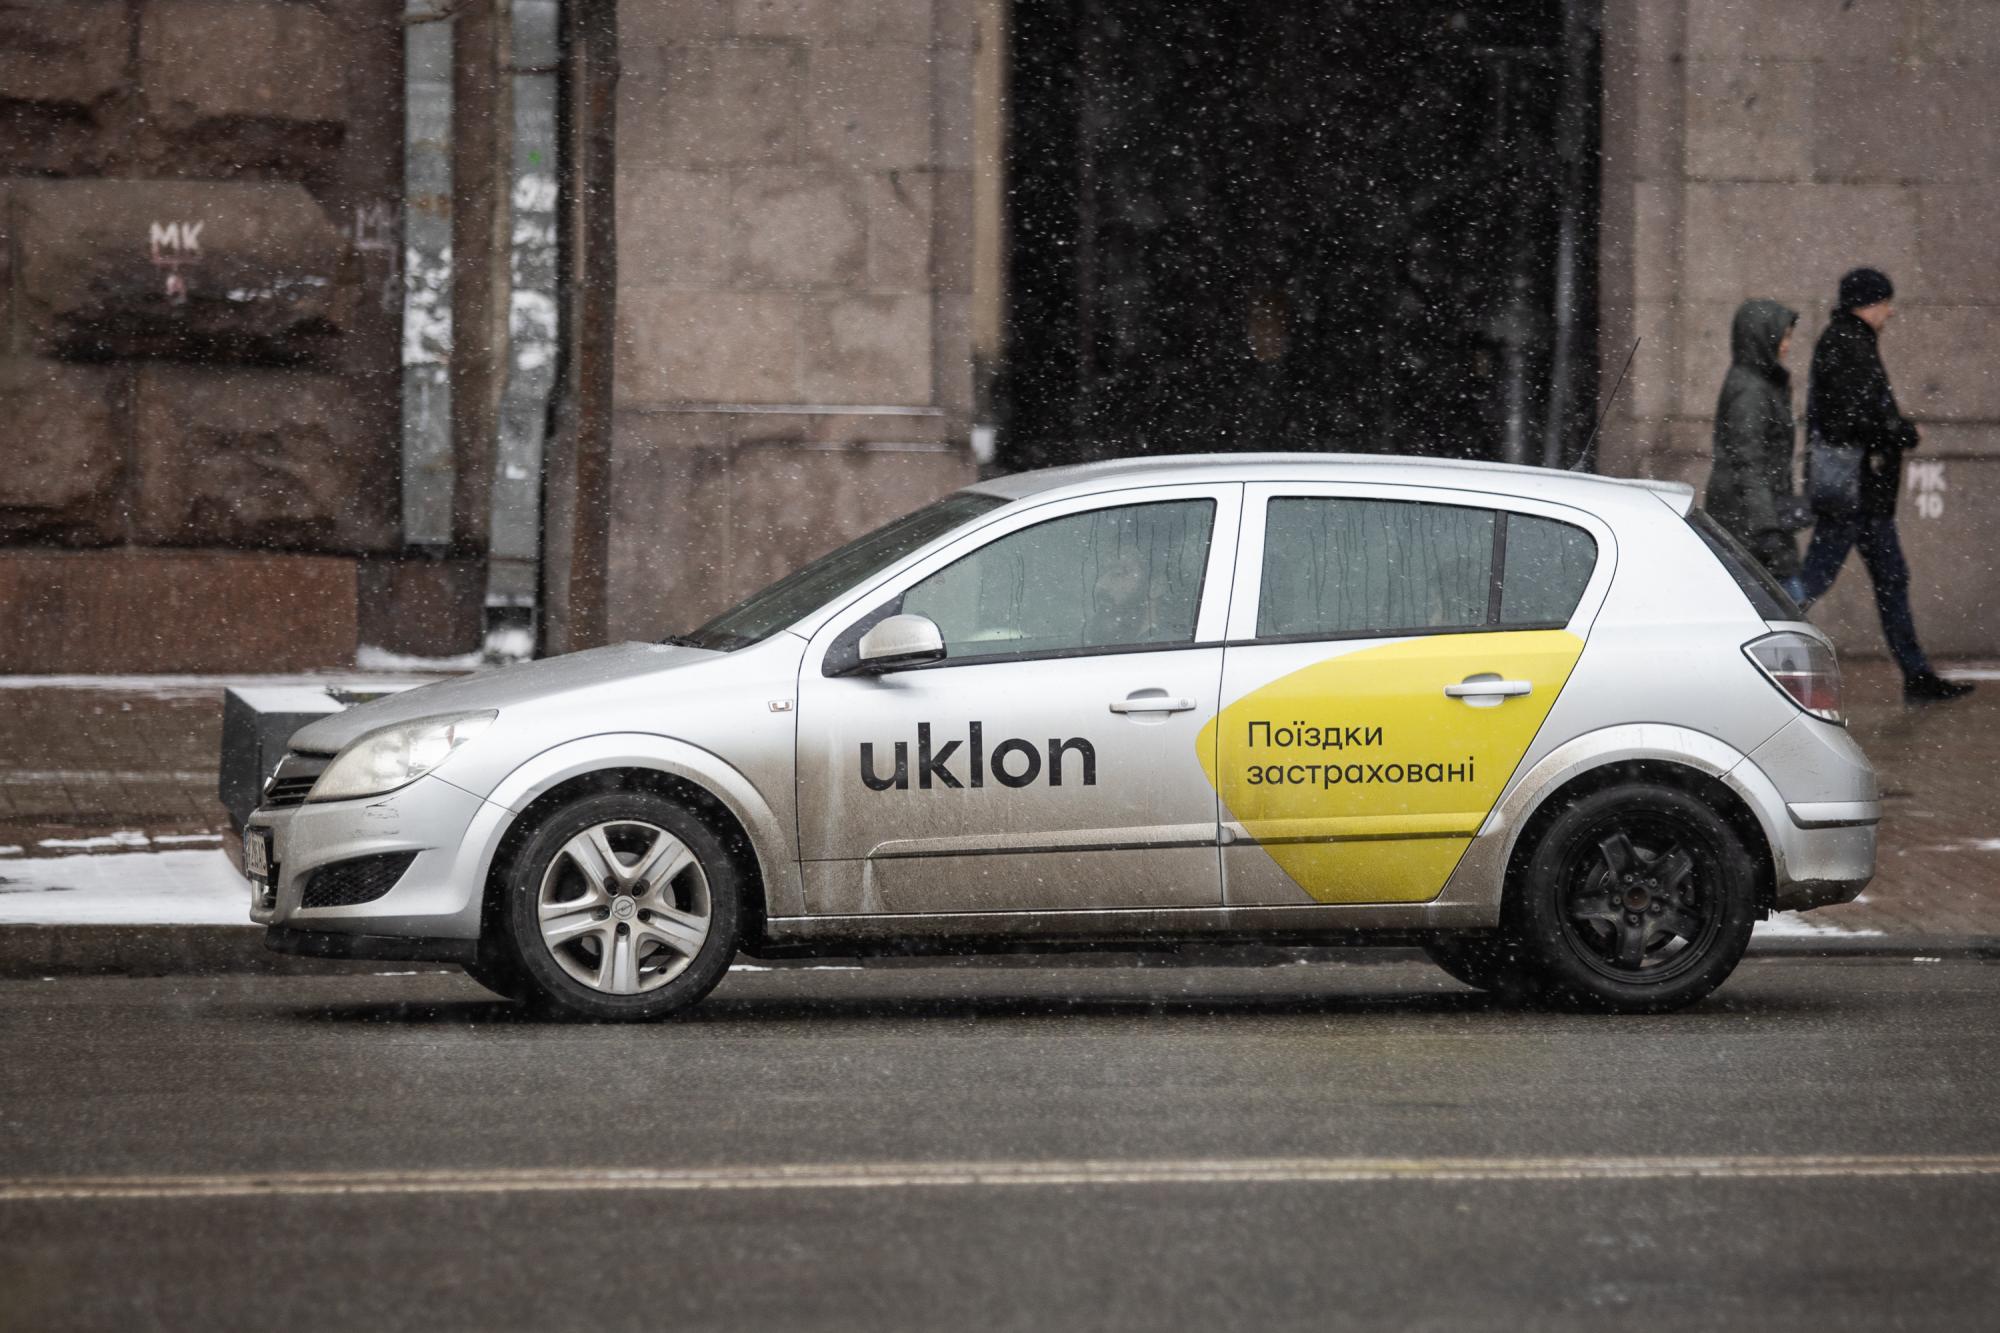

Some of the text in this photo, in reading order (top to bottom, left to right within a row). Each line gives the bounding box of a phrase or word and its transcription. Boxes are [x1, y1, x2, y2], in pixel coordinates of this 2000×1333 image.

[1248, 721, 1383, 750] Поїздки
[860, 721, 1096, 791] uklon
[1246, 756, 1474, 790] застраховані
